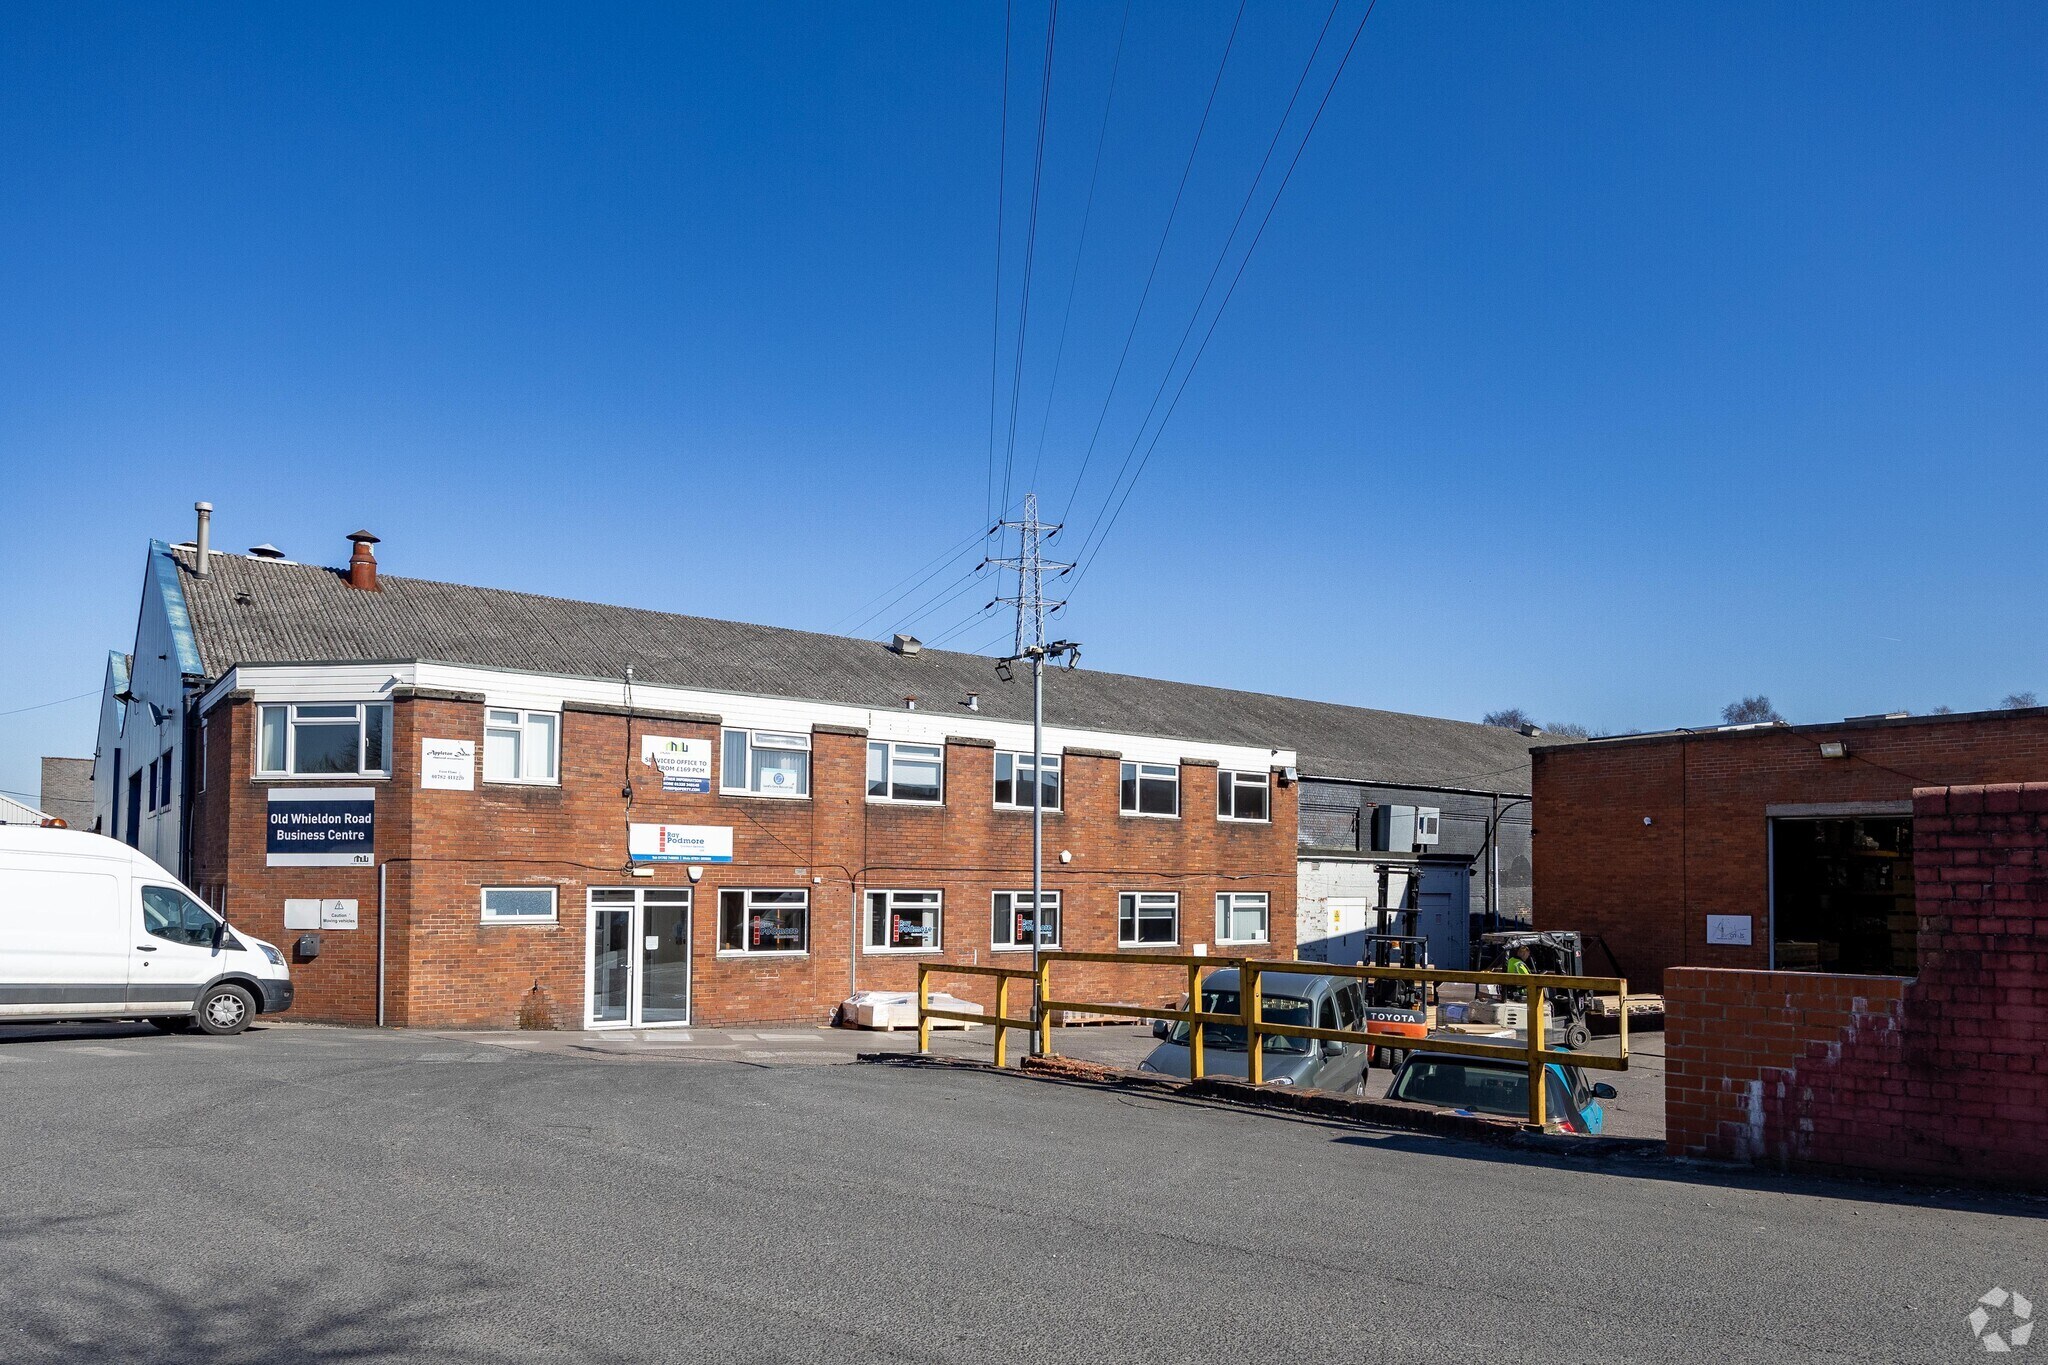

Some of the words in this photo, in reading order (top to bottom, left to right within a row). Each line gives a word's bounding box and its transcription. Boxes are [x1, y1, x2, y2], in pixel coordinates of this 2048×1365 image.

[270, 813, 288, 824] Old
[291, 813, 341, 824] Whieldon
[344, 812, 372, 824] Road
[276, 829, 325, 840] Business
[327, 829, 365, 840] Centre
[899, 925, 932, 933] Podmore
[1371, 1012, 1415, 1023] TOYOTA
